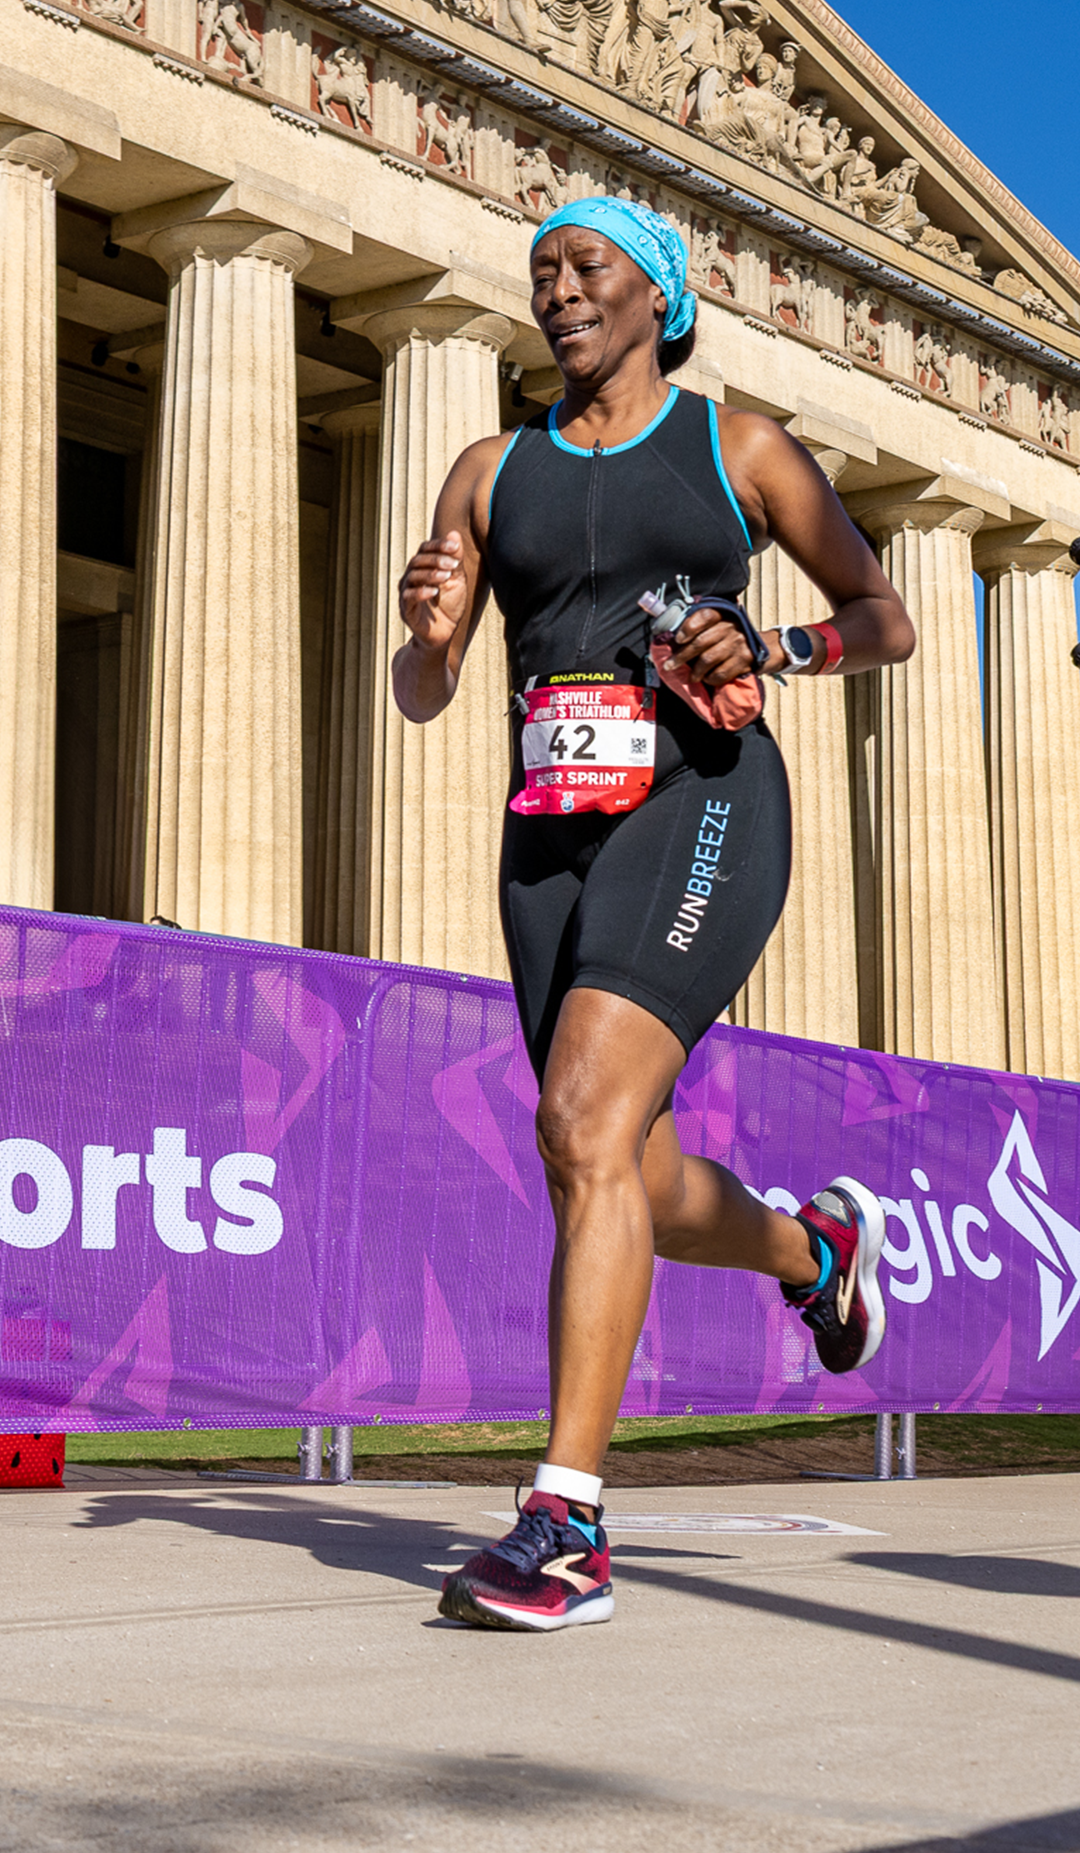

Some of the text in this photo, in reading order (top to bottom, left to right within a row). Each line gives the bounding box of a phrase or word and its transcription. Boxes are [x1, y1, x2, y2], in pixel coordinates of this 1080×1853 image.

[559, 672, 615, 683] NATHAN
[568, 705, 631, 719] TRIATHLON
[548, 724, 597, 760] 42
[567, 771, 628, 786] SPRINT
[666, 799, 731, 952] RUNBREEZE
[0, 1126, 284, 1256] orts
[744, 1168, 1003, 1304] gic
